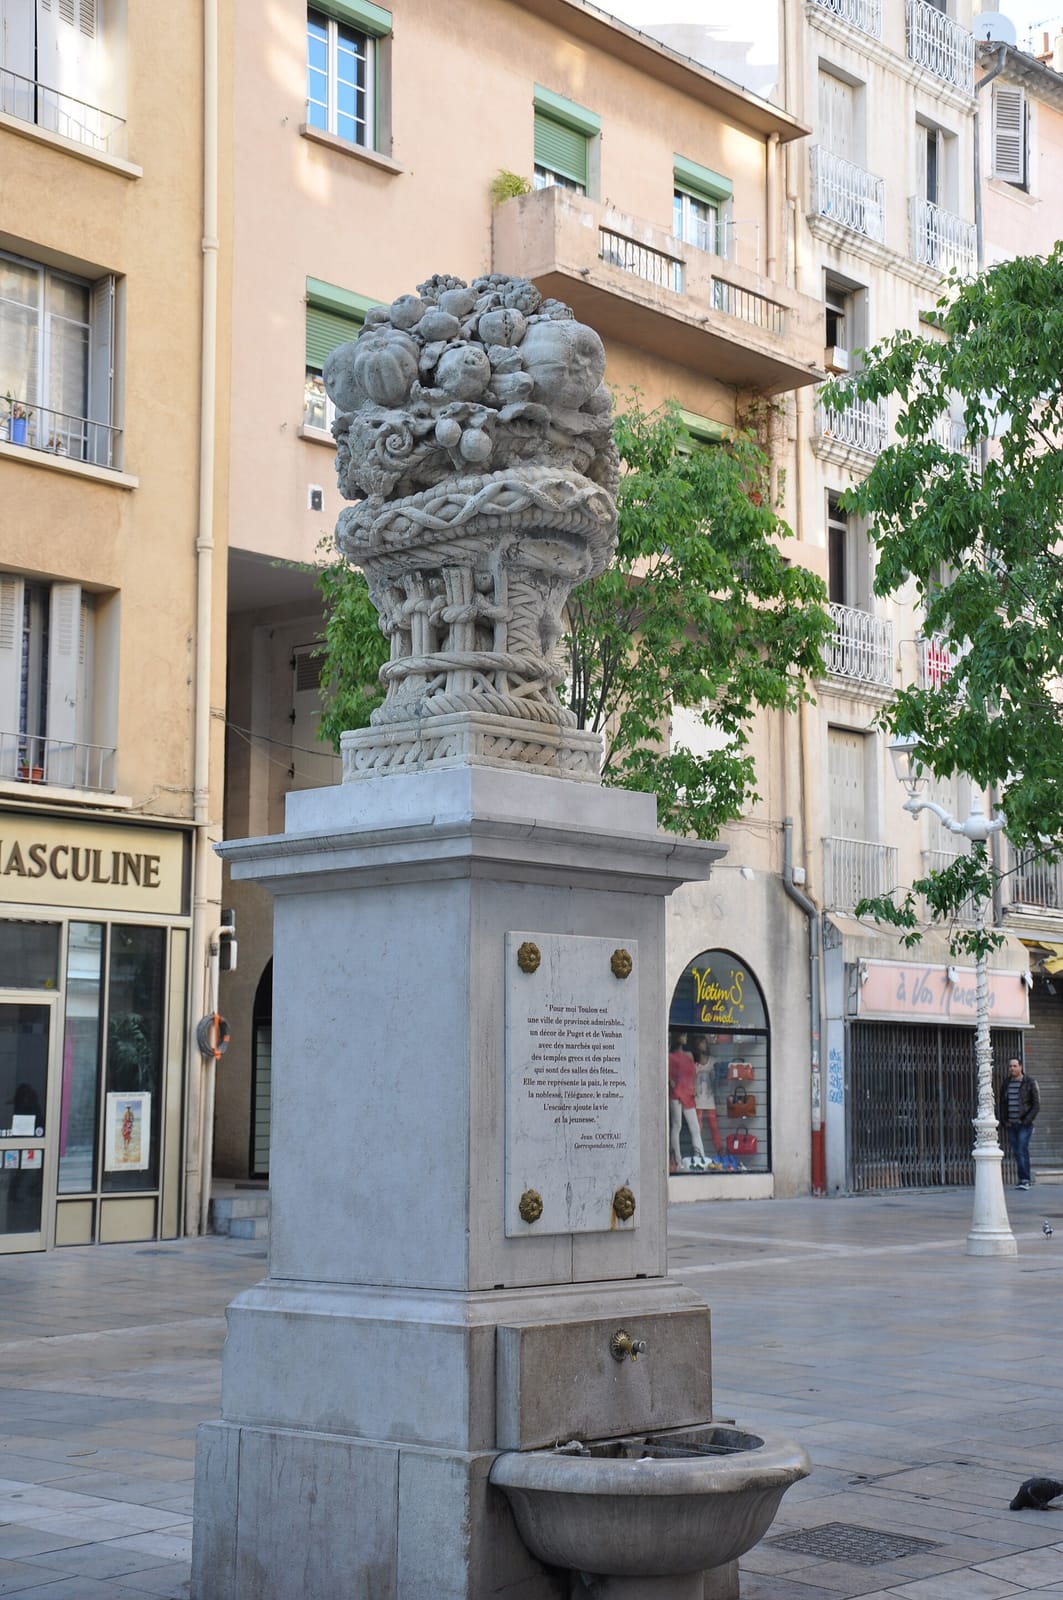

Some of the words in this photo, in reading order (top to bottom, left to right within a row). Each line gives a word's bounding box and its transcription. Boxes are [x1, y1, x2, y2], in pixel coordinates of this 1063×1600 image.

[0, 840, 161, 888] ASCULINE
[912, 968, 933, 1006] Vos
[940, 978, 995, 1016] Marqs
[565, 1005, 577, 1014] moi
[578, 1005, 598, 1014] Toulon
[599, 1006, 608, 1014] est
[712, 1000, 725, 1011] de
[701, 1004, 713, 1023] la
[540, 1016, 554, 1024] ville
[555, 1016, 562, 1024] de
[563, 1018, 589, 1026] province
[539, 1028, 556, 1036] décor
[566, 1030, 584, 1039] Puget
[593, 1030, 600, 1038] de
[601, 1030, 623, 1038] Vauban
[553, 1041, 564, 1049] des
[565, 1042, 590, 1050] marchés
[592, 1043, 601, 1051] qui
[531, 1053, 542, 1061] des
[543, 1053, 567, 1063] temples
[568, 1055, 584, 1063] grecs
[592, 1054, 601, 1062] des
[602, 1054, 621, 1063] places
[534, 1066, 544, 1075] qui
[571, 1066, 588, 1074] salles
[523, 1078, 535, 1086] Elle
[547, 1079, 580, 1087] représente
[609, 1080, 627, 1088] repos,
[528, 1090, 534, 1098] la
[535, 1090, 563, 1098] noblesse,
[573, 1103, 592, 1112] ajoute
[592, 1103, 599, 1111] la
[599, 1103, 608, 1111] vie
